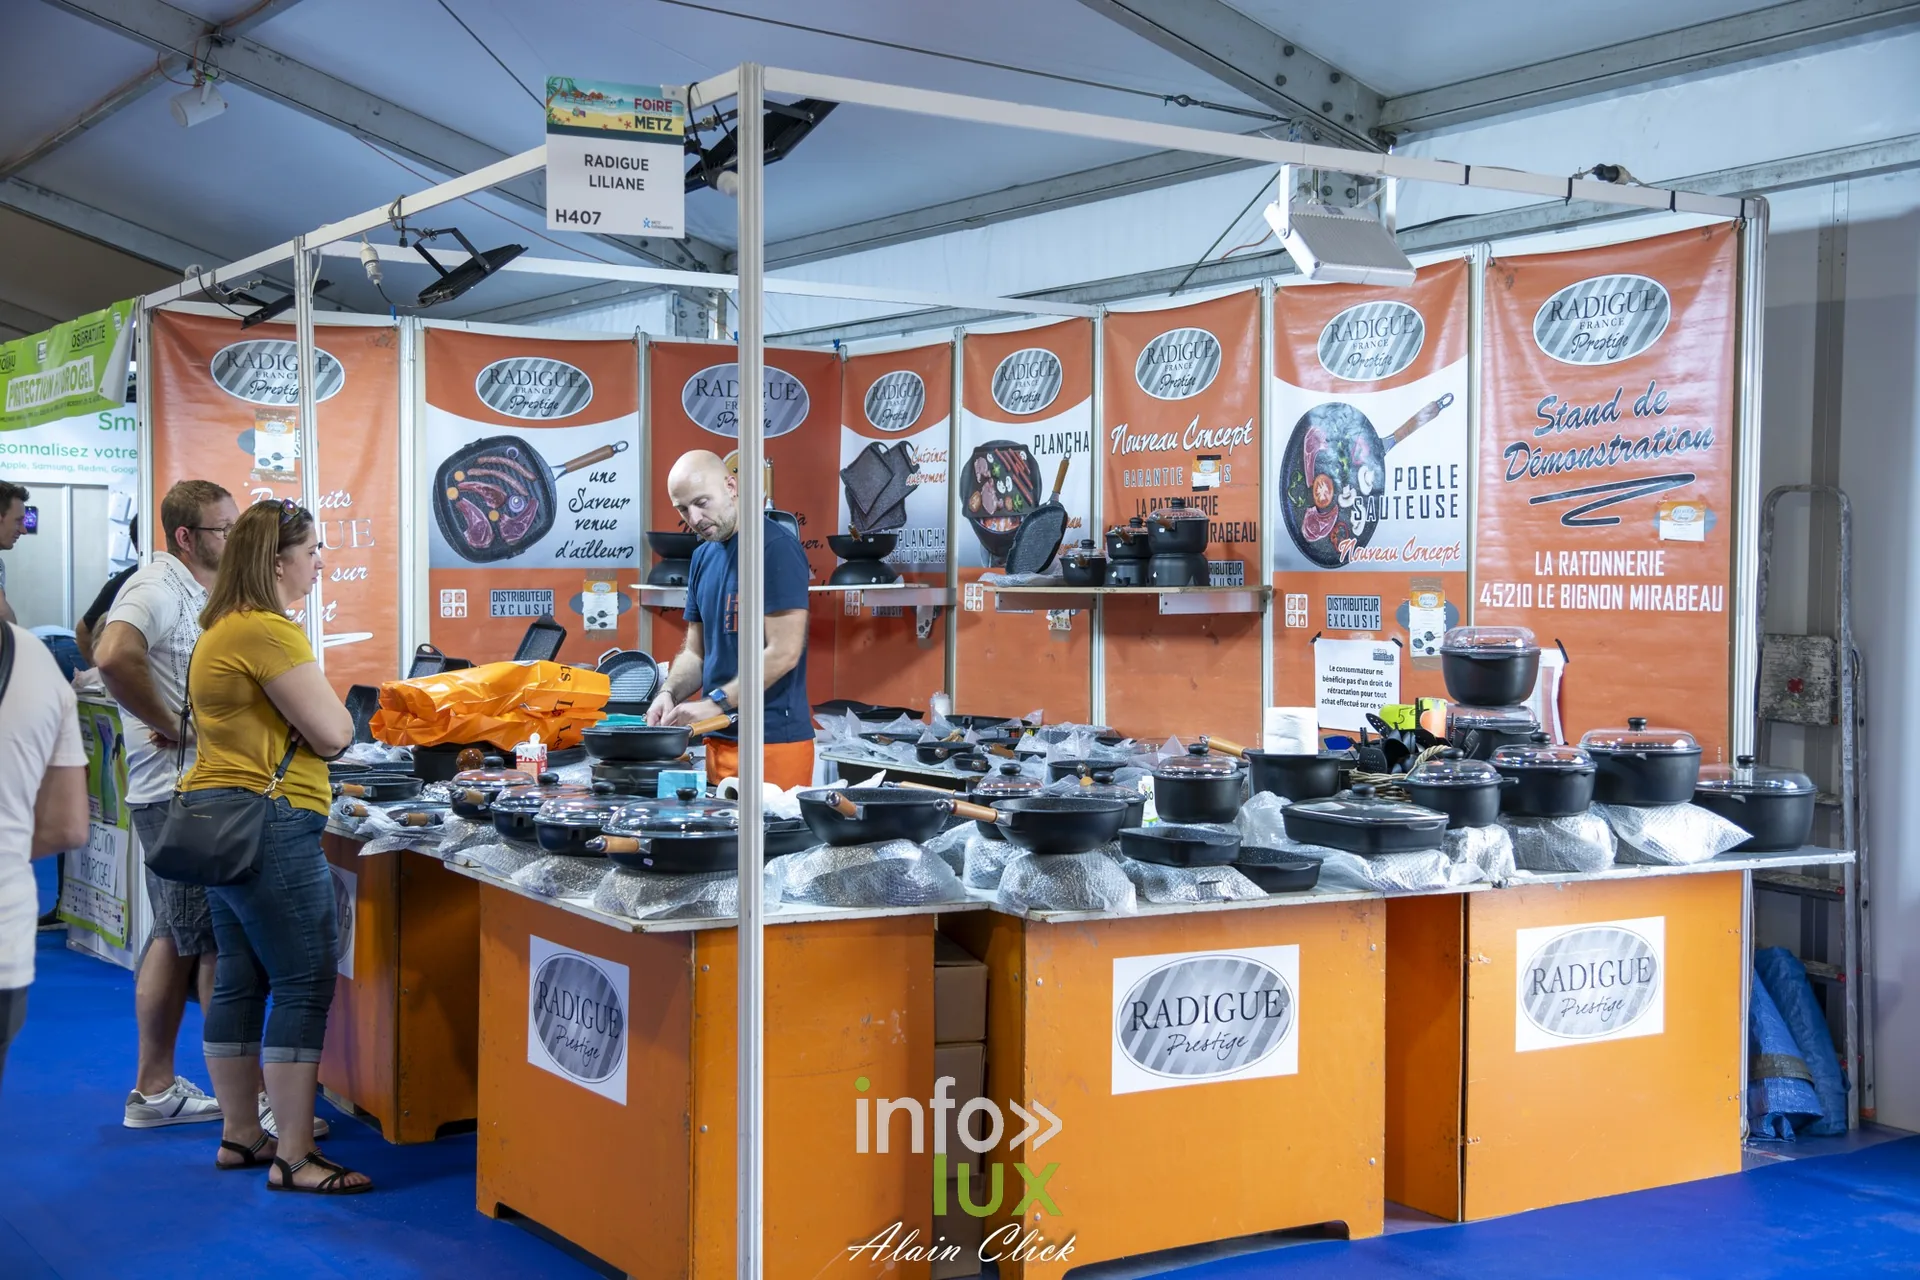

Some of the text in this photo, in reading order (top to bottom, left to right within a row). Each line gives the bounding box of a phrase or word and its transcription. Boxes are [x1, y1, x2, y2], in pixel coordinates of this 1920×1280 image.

[634, 115, 673, 132] METZ
[584, 154, 649, 171] RADIGUE
[589, 174, 645, 191] LILIANE
[555, 208, 602, 226] H407
[1549, 288, 1660, 322] RADIGUE
[1329, 313, 1415, 344] RADIGUE
[1579, 317, 1625, 330] FRANCE
[1146, 340, 1215, 365] RADIGUE
[1353, 339, 1389, 350] FRANCE
[1571, 332, 1629, 359] Prestige
[226, 350, 332, 374] RADIGE
[1000, 360, 1057, 382] RADIGUE
[1164, 362, 1193, 372] FRANCE
[1346, 352, 1393, 376] Prestige
[488, 368, 582, 388] RADIGUE
[1159, 373, 1197, 395] Prestige
[514, 386, 554, 395] FRANCE
[509, 394, 559, 418] Prestige
[1533, 379, 1671, 437] Stand de
[1033, 431, 1090, 456] PLANCHA
[1111, 414, 1254, 456] Nouveau Concept
[94, 446, 137, 459] votre
[1503, 425, 1716, 483] Démonstration
[588, 471, 617, 483] une
[1124, 467, 1183, 487] GARANTIE
[1394, 464, 1459, 491] POELE
[568, 487, 631, 513] Saveur
[1353, 493, 1459, 521] SAUTEUSE
[574, 518, 618, 531] venue
[555, 539, 634, 559] d'ailleurs
[897, 529, 946, 549] PLANCHA
[1338, 535, 1461, 568] Nouveau Concept
[330, 565, 369, 582] sur
[1535, 550, 1666, 577] LA RATONNERIE
[492, 590, 552, 602] DISTRIBUTEUR
[1327, 597, 1379, 612] DISTRIBUTEUR
[1480, 583, 1724, 613] 45210 LE BIGNON MIRABEAU
[492, 604, 553, 616] EXCLUSIF
[1328, 613, 1380, 629] EXCLUSIF
[1322, 675, 1346, 683] bénéficie
[1346, 678, 1357, 686] pas
[1357, 678, 1369, 686] d'un
[1369, 679, 1384, 687] droit
[1336, 666, 1375, 675] consommateur
[1321, 698, 1336, 706] achat
[1336, 699, 1360, 707] effectué
[1327, 688, 1387, 699] rétractation pour tout
[1530, 956, 1653, 996] RADIGUE
[538, 981, 620, 1039] RADIGUE
[1130, 989, 1284, 1032] RADIGUE
[1560, 996, 1626, 1022] Prestige
[556, 1024, 601, 1067] Prestige
[1166, 1031, 1250, 1061] Prestige
